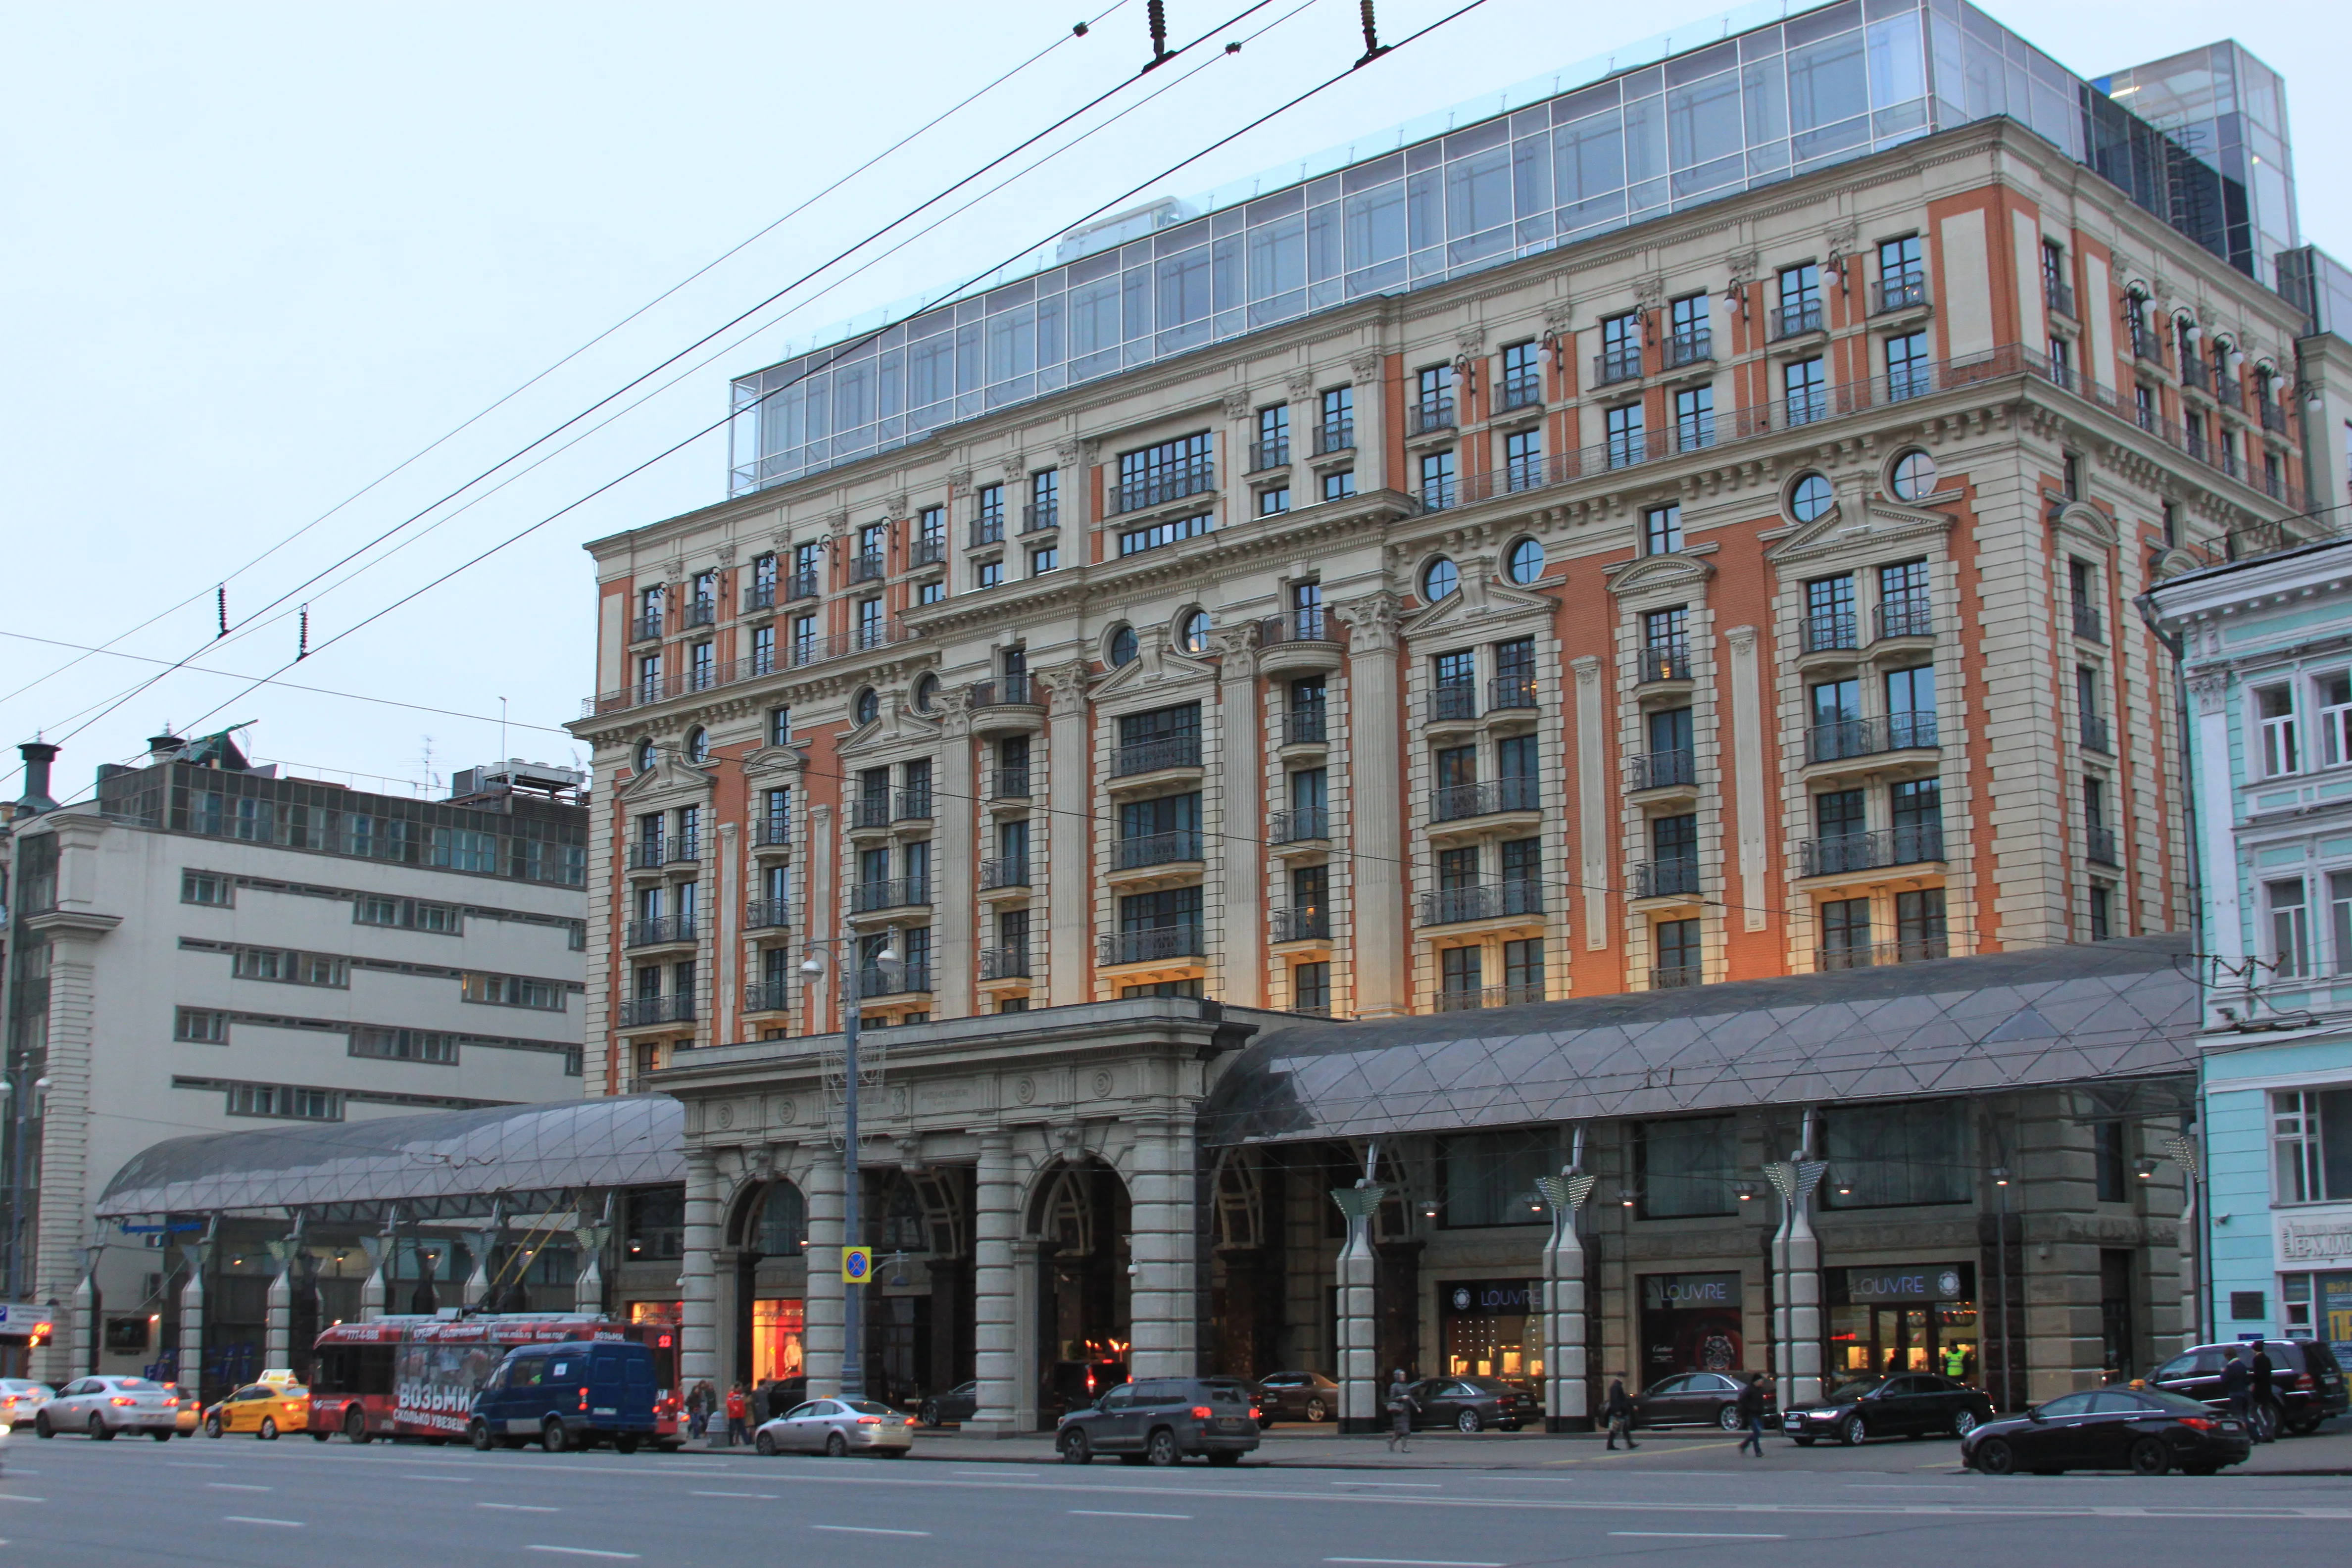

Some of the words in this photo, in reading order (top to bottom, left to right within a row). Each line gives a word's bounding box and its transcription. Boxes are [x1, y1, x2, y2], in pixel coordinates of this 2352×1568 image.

[1661, 1282, 1726, 1301] LOUVRE
[1854, 1275, 1924, 1295] LOUVRE
[1481, 1289, 1542, 1306] LOUVRE
[399, 1383, 471, 1413] ВОЗЬМИ
[393, 1408, 431, 1426] СКОЛЬКО
[430, 1413, 468, 1432] УВЕЗЕШ
